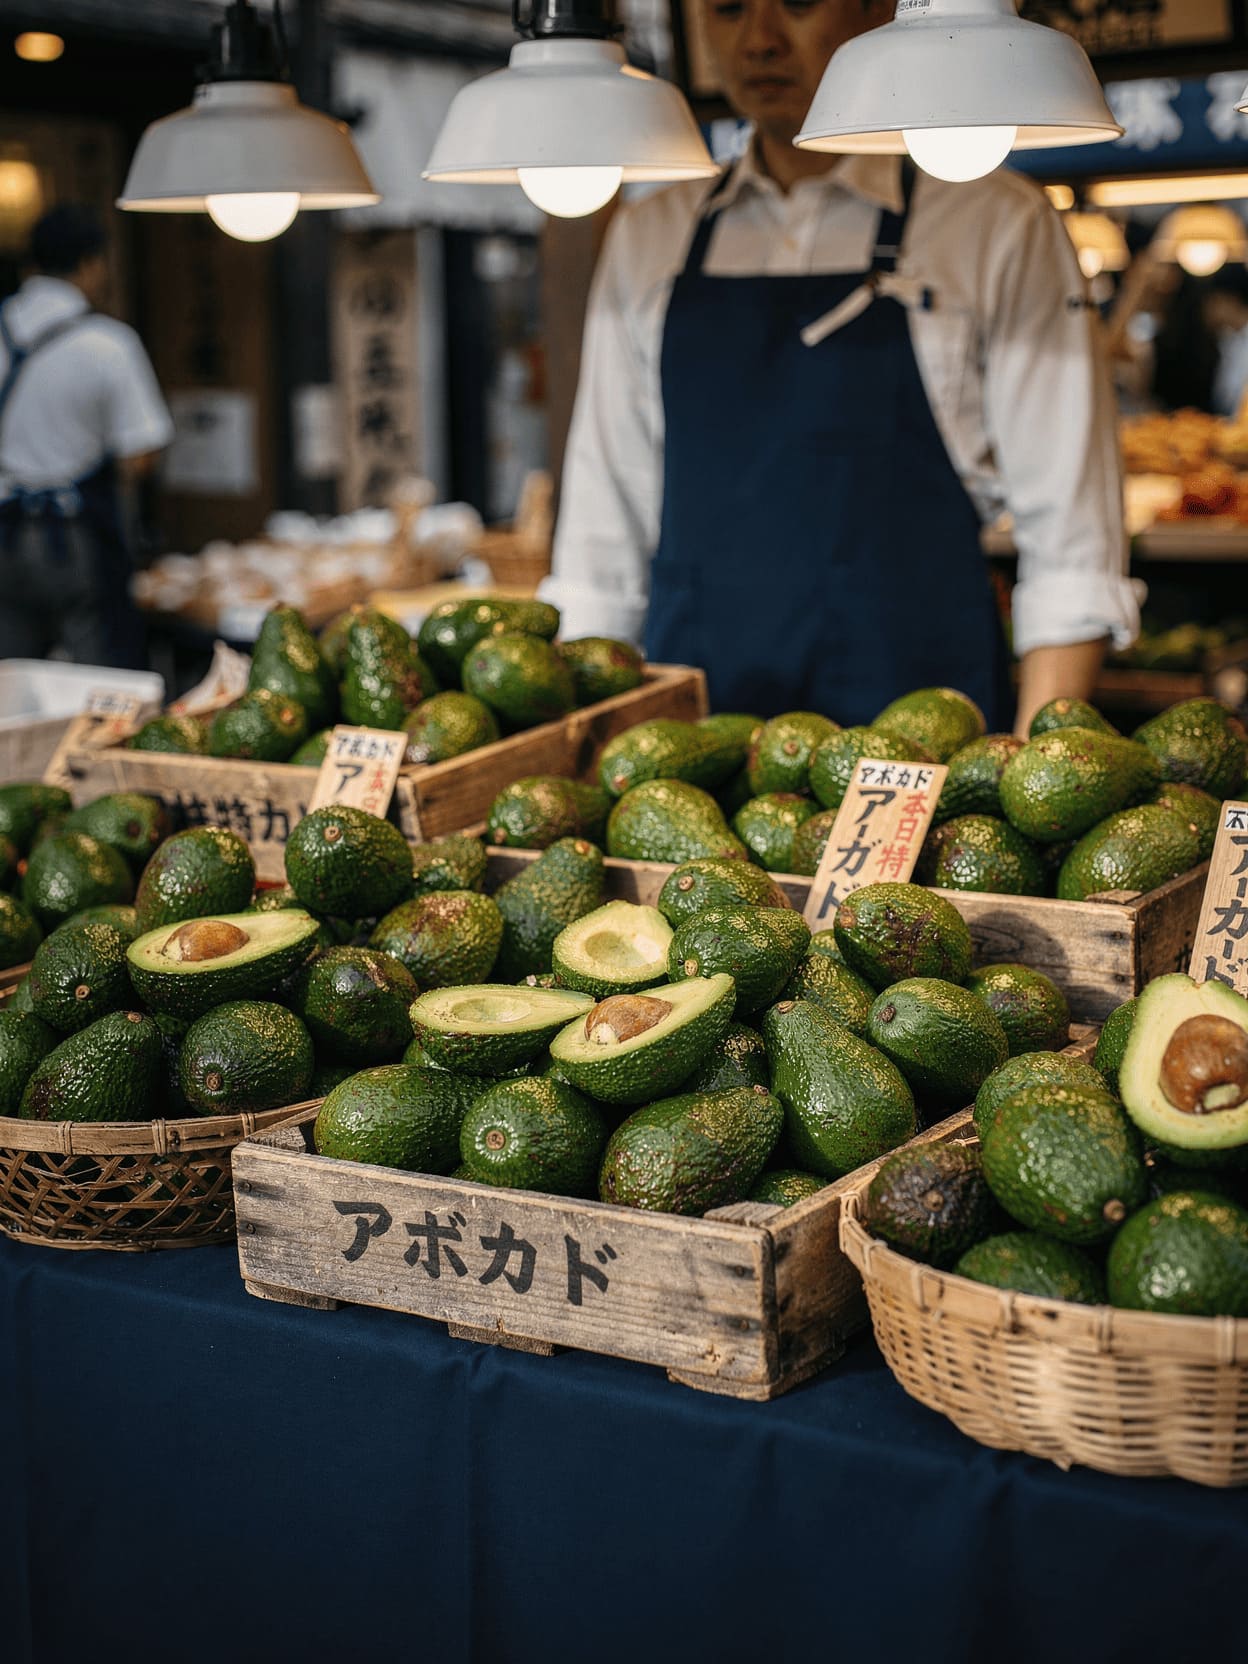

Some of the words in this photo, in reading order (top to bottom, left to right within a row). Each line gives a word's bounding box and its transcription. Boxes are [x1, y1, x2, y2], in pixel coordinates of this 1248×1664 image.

[860, 765, 932, 790] アボカド
[332, 1200, 618, 1306] アボカド
